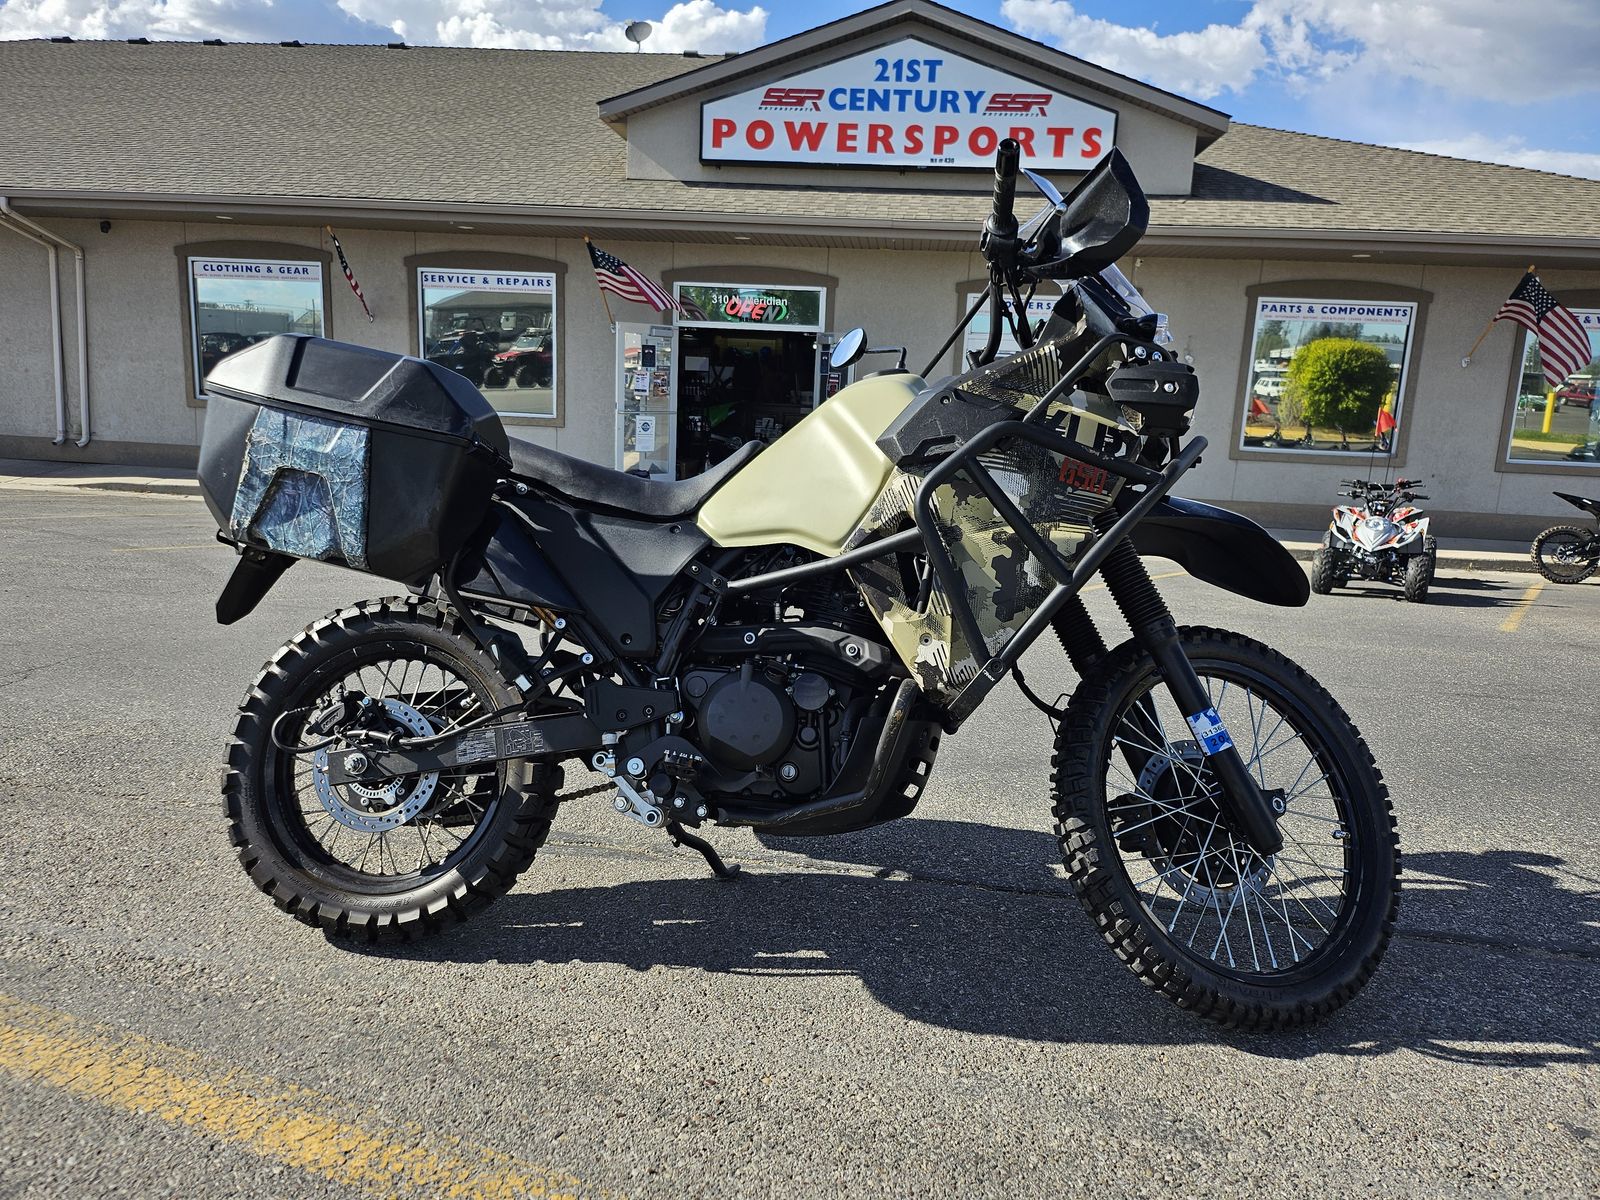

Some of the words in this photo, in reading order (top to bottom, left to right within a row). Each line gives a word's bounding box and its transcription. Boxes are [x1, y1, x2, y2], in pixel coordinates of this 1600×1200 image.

[874, 58, 943, 83] 21ST
[760, 88, 825, 112] SSR
[828, 87, 985, 114] CENTURY
[985, 93, 1053, 117] SSR
[711, 118, 1102, 159] POWERSPORTS
[202, 264, 261, 273] CLOTHING
[266, 265, 273, 274] &
[278, 266, 310, 275] GEAR
[423, 274, 476, 284] SERVICE
[496, 277, 551, 287] REPAIRS
[711, 294, 729, 304] 310
[745, 296, 787, 306] Meridian
[725, 297, 780, 321] OPEN
[1261, 304, 1302, 313] PARTS
[1307, 305, 1315, 314] &
[1320, 306, 1408, 317] COMPONENTS
[1583, 315, 1591, 324] &
[1058, 455, 1108, 495] 650
